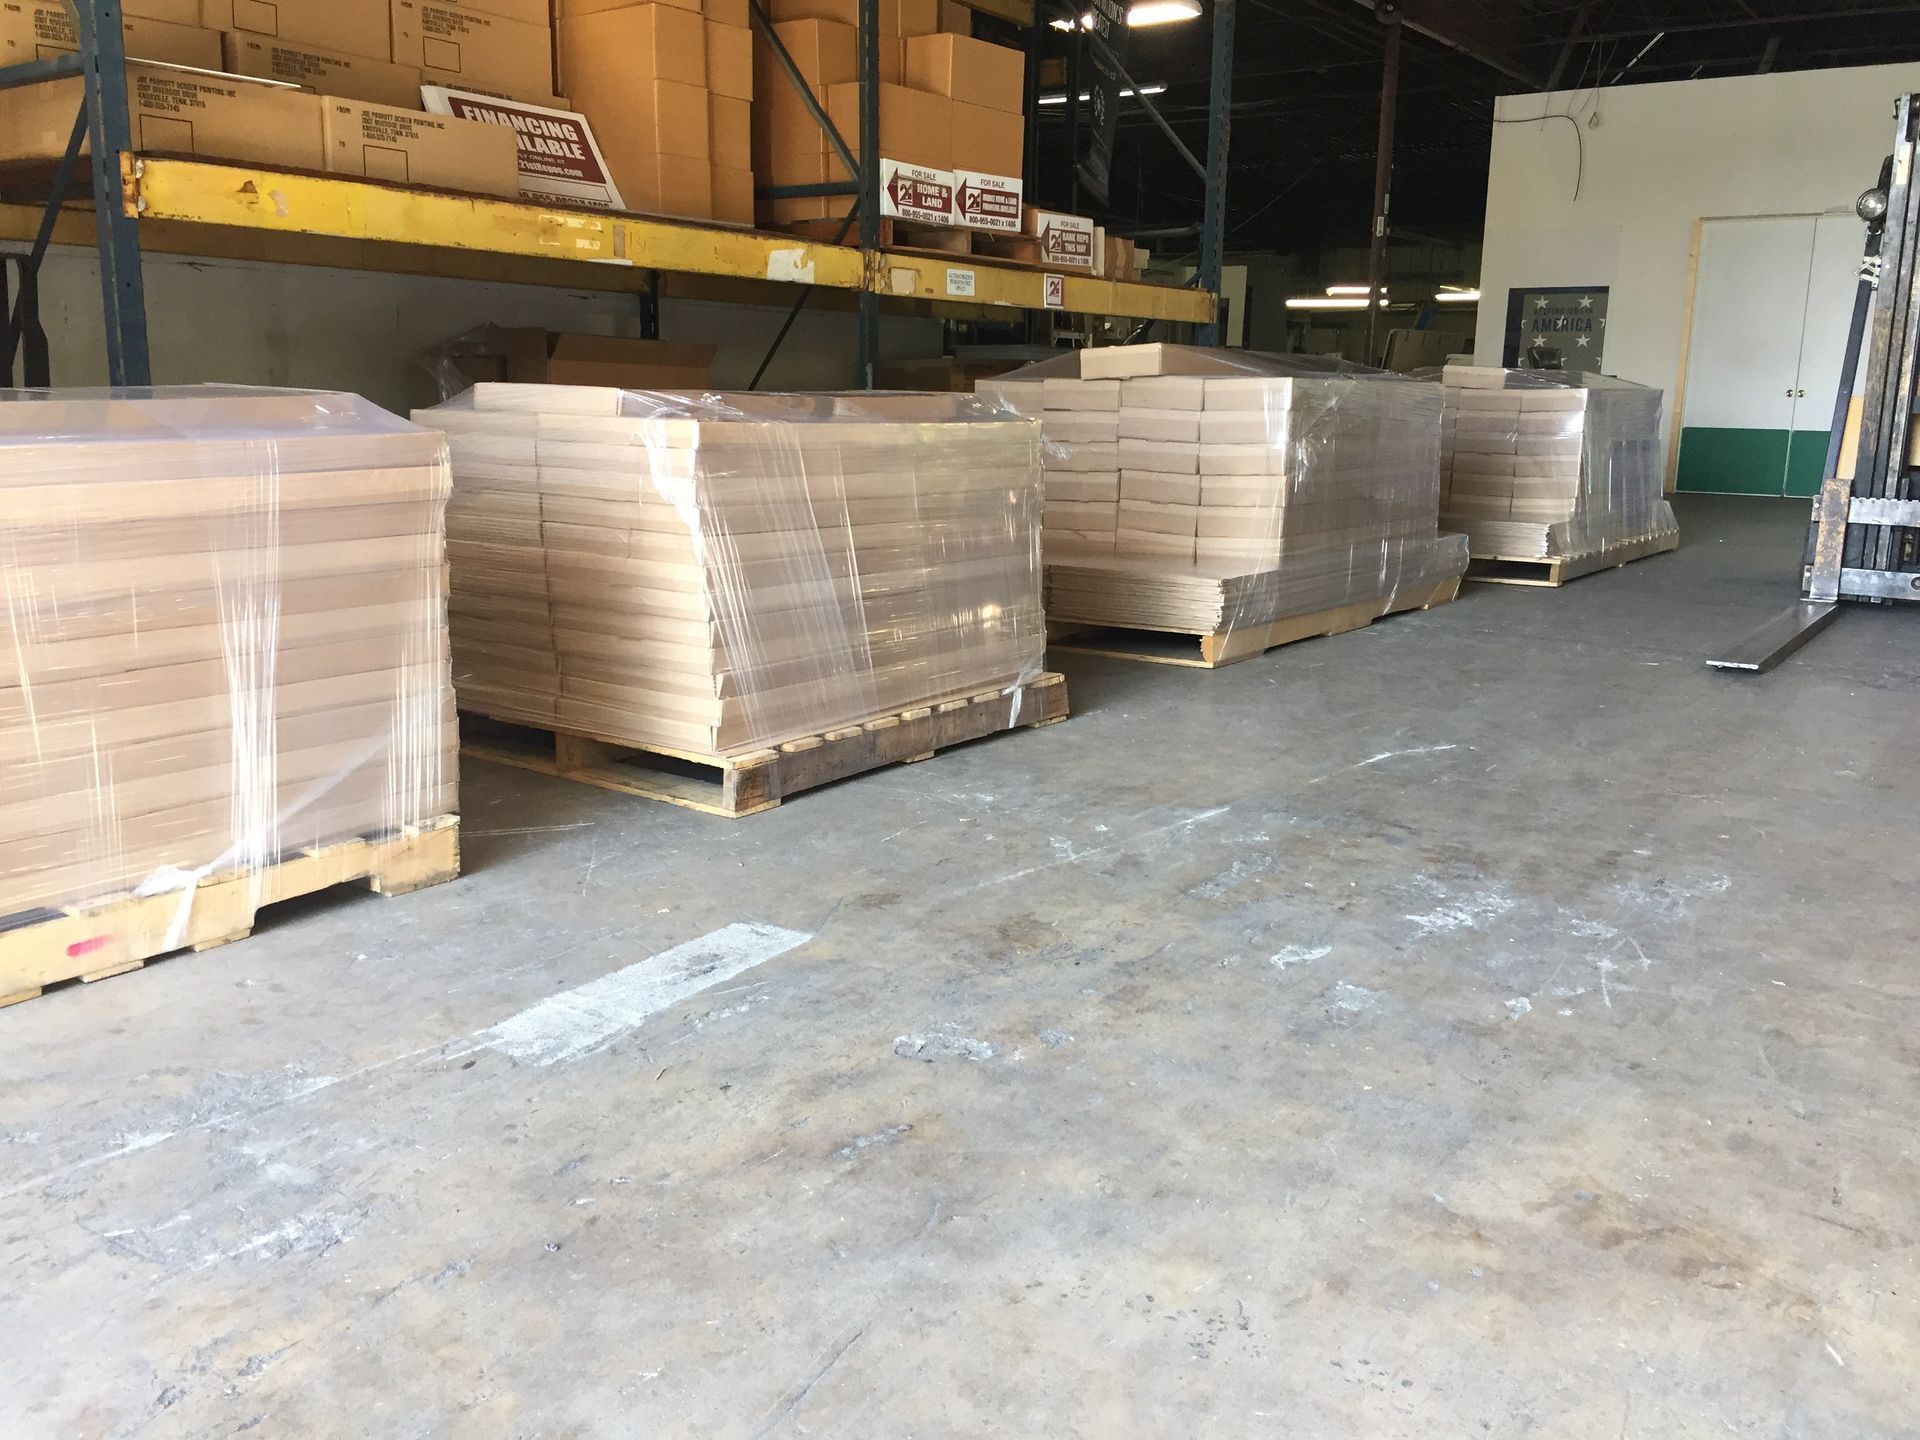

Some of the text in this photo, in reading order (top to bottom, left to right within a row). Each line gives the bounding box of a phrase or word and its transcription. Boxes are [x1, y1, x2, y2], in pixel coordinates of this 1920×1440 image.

[461, 104, 579, 142] FINANCING
[516, 134, 586, 160] ILABLE
[912, 169, 936, 180] FOR SALE
[980, 179, 1004, 188] FOR SALE
[917, 183, 940, 197] HOME
[941, 187, 948, 198] &
[922, 196, 943, 208] LAND
[902, 208, 934, 221] 800-955-0021
[969, 216, 1000, 227] 800-955-0021
[1060, 220, 1080, 230] FOR SALE
[1062, 232, 1075, 242] BANK
[1076, 234, 1089, 243] REPO
[1064, 242, 1087, 252] THIS WAY
[1532, 318, 1592, 332] AMERICA
